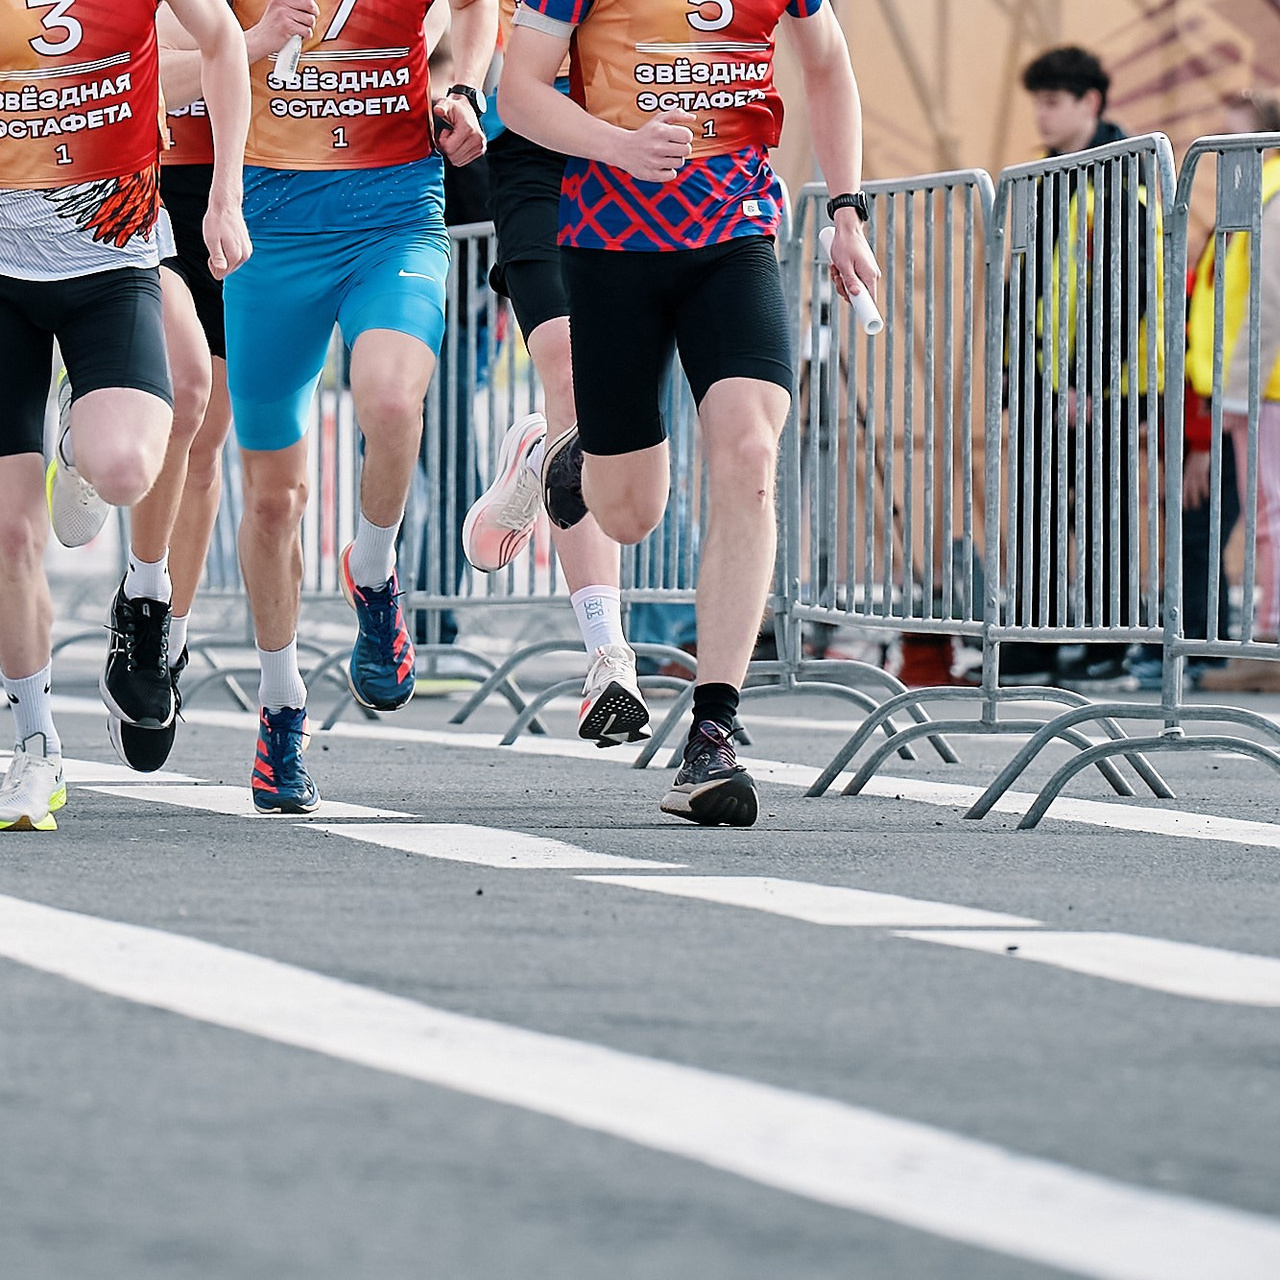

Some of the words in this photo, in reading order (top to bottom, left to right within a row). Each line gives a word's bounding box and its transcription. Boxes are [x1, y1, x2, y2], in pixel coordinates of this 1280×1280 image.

[634, 57, 770, 86] ЗВЁЗДНАЯ
[270, 95, 411, 119] ЭСТАФЕТА
[331, 126, 349, 148] 1
[701, 119, 717, 139] 1
[54, 143, 73, 165] 1
